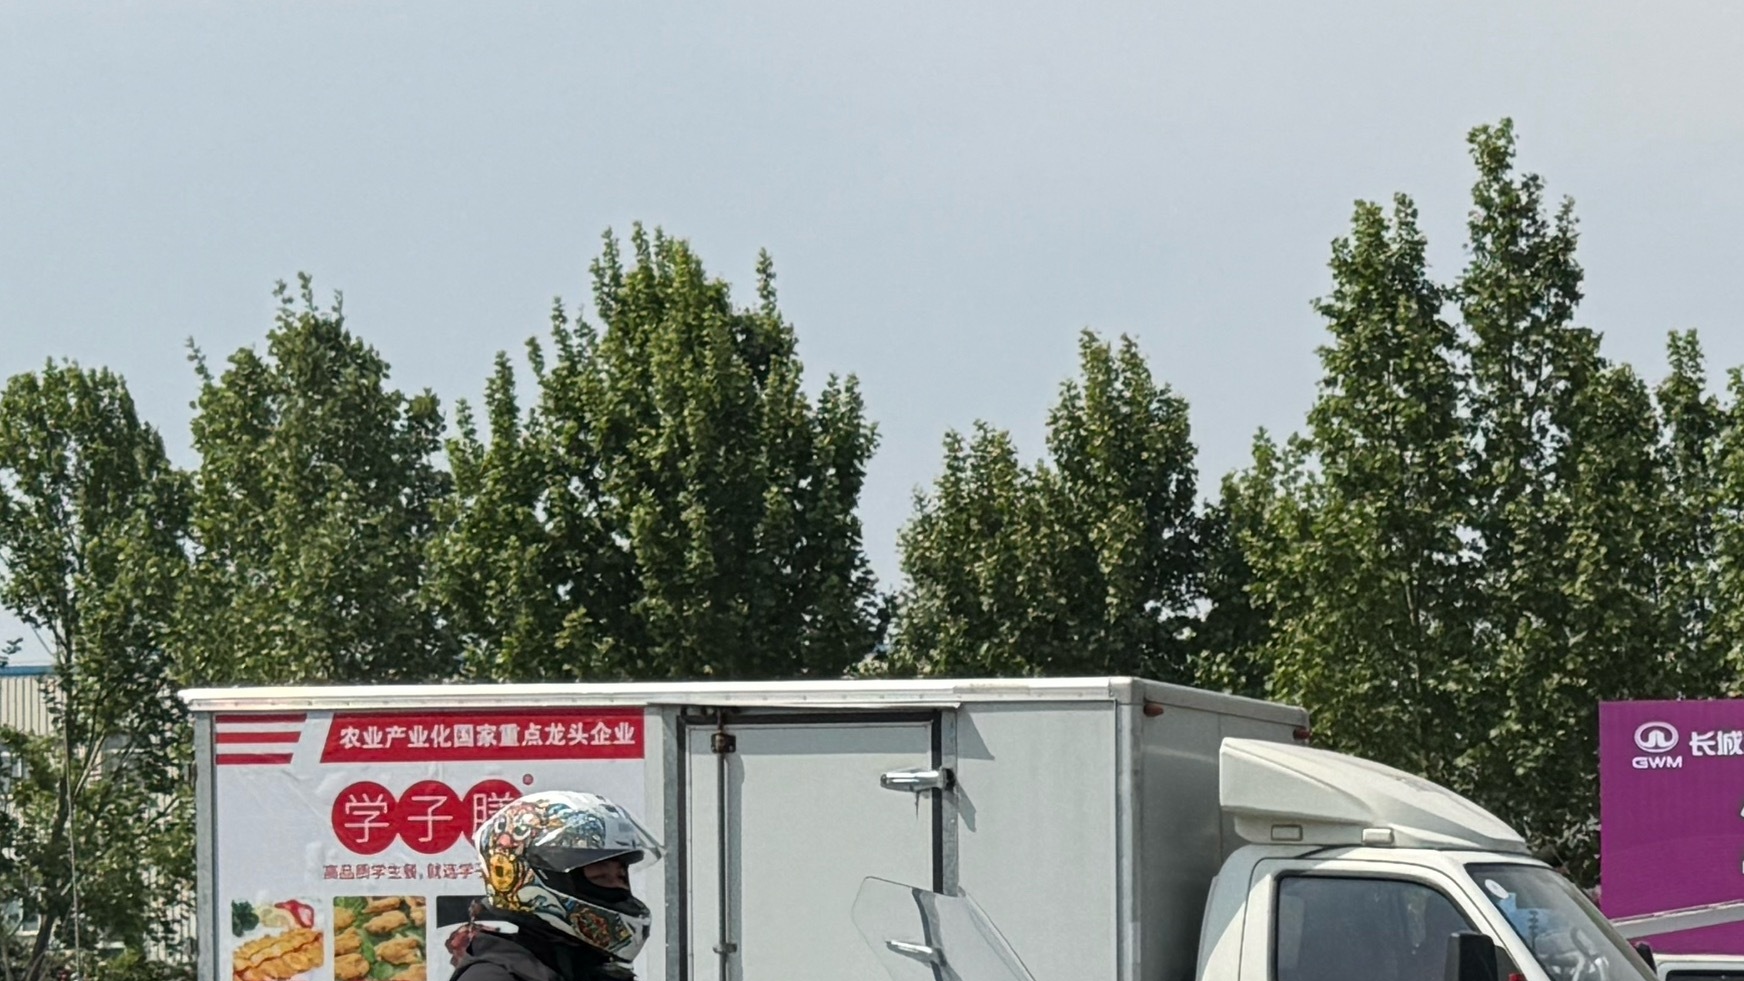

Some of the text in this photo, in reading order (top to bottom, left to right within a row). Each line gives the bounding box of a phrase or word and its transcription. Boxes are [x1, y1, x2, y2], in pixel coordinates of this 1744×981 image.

[340, 722, 635, 749] 农业产业化国家重点龙头企业
[1632, 756, 1682, 769] GWM
